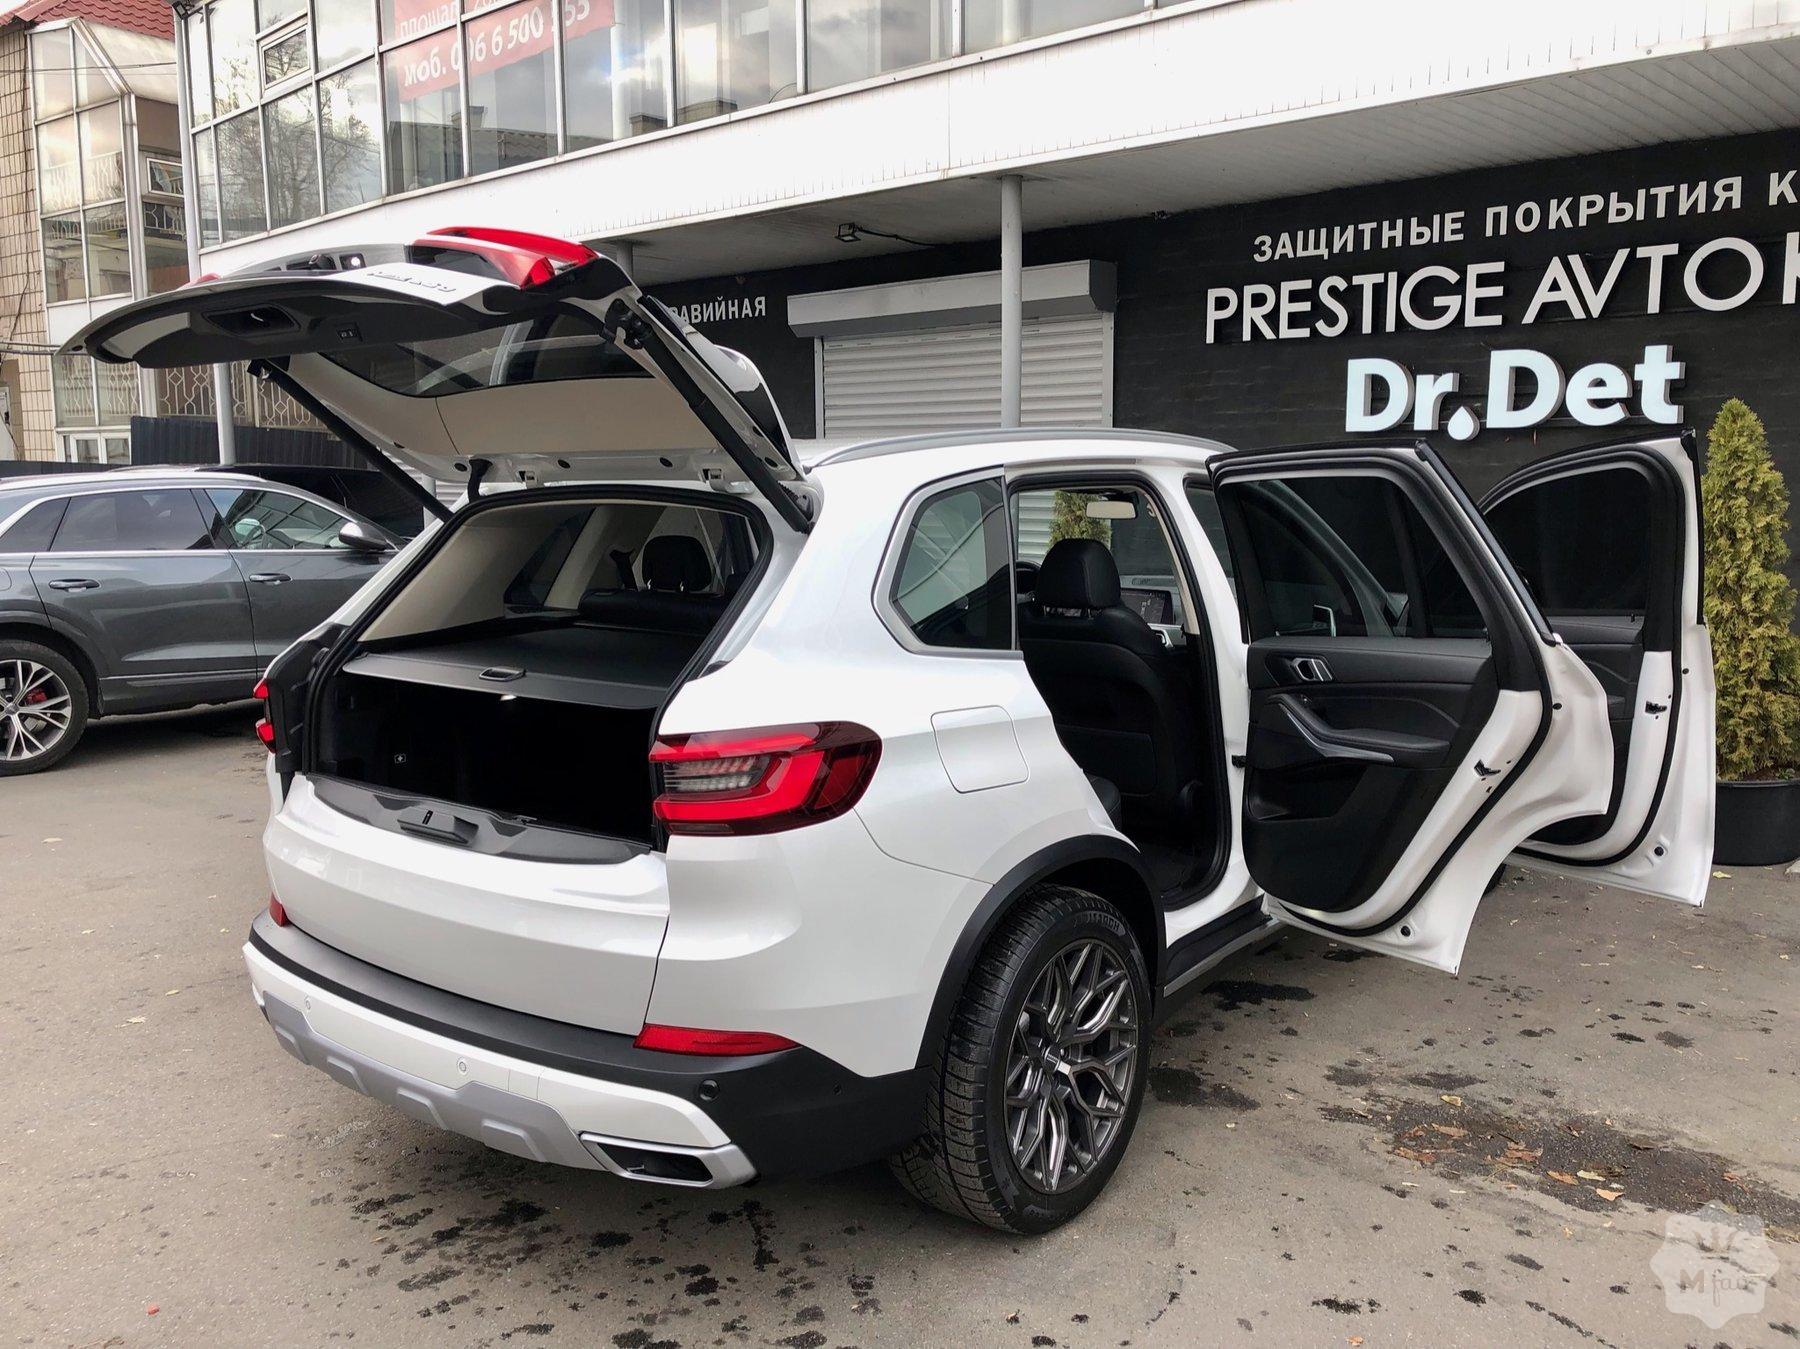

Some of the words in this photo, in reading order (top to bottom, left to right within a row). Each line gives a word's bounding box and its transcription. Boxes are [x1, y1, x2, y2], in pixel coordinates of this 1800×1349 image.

[404, 46, 447, 87] моб.
[491, 25, 504, 56] 6
[508, 6, 544, 49] 500
[1253, 210, 1465, 263] ЗАЩИТНЫЕ
[1485, 175, 1743, 237] ПОКРЫТИЯ
[1205, 262, 1505, 344] PRESTIGE
[1521, 236, 1764, 325] AVTO
